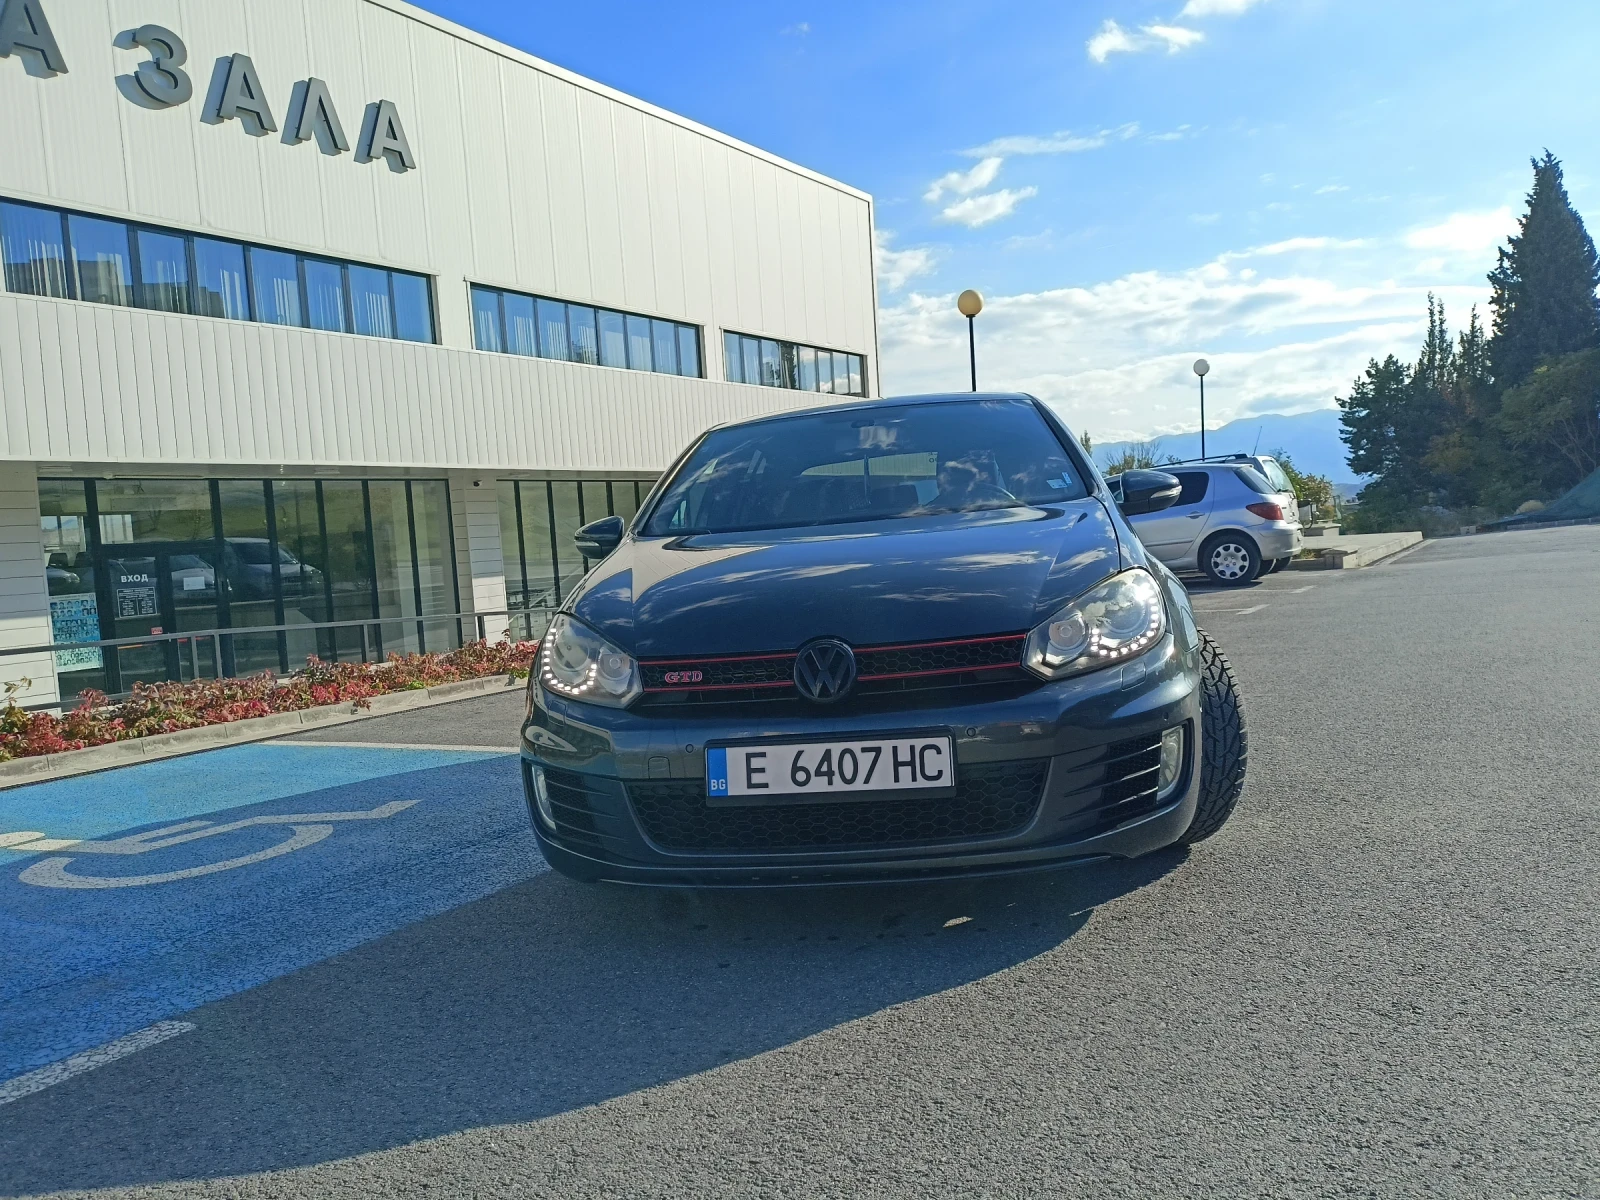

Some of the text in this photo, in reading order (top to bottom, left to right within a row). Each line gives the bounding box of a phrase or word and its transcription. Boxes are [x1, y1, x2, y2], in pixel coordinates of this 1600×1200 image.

[113, 24, 417, 174] ЗАЛА
[120, 573, 149, 583] ВХОД
[664, 670, 703, 684] GTD
[745, 743, 944, 790] E 6407 HC
[710, 779, 727, 791] BG
